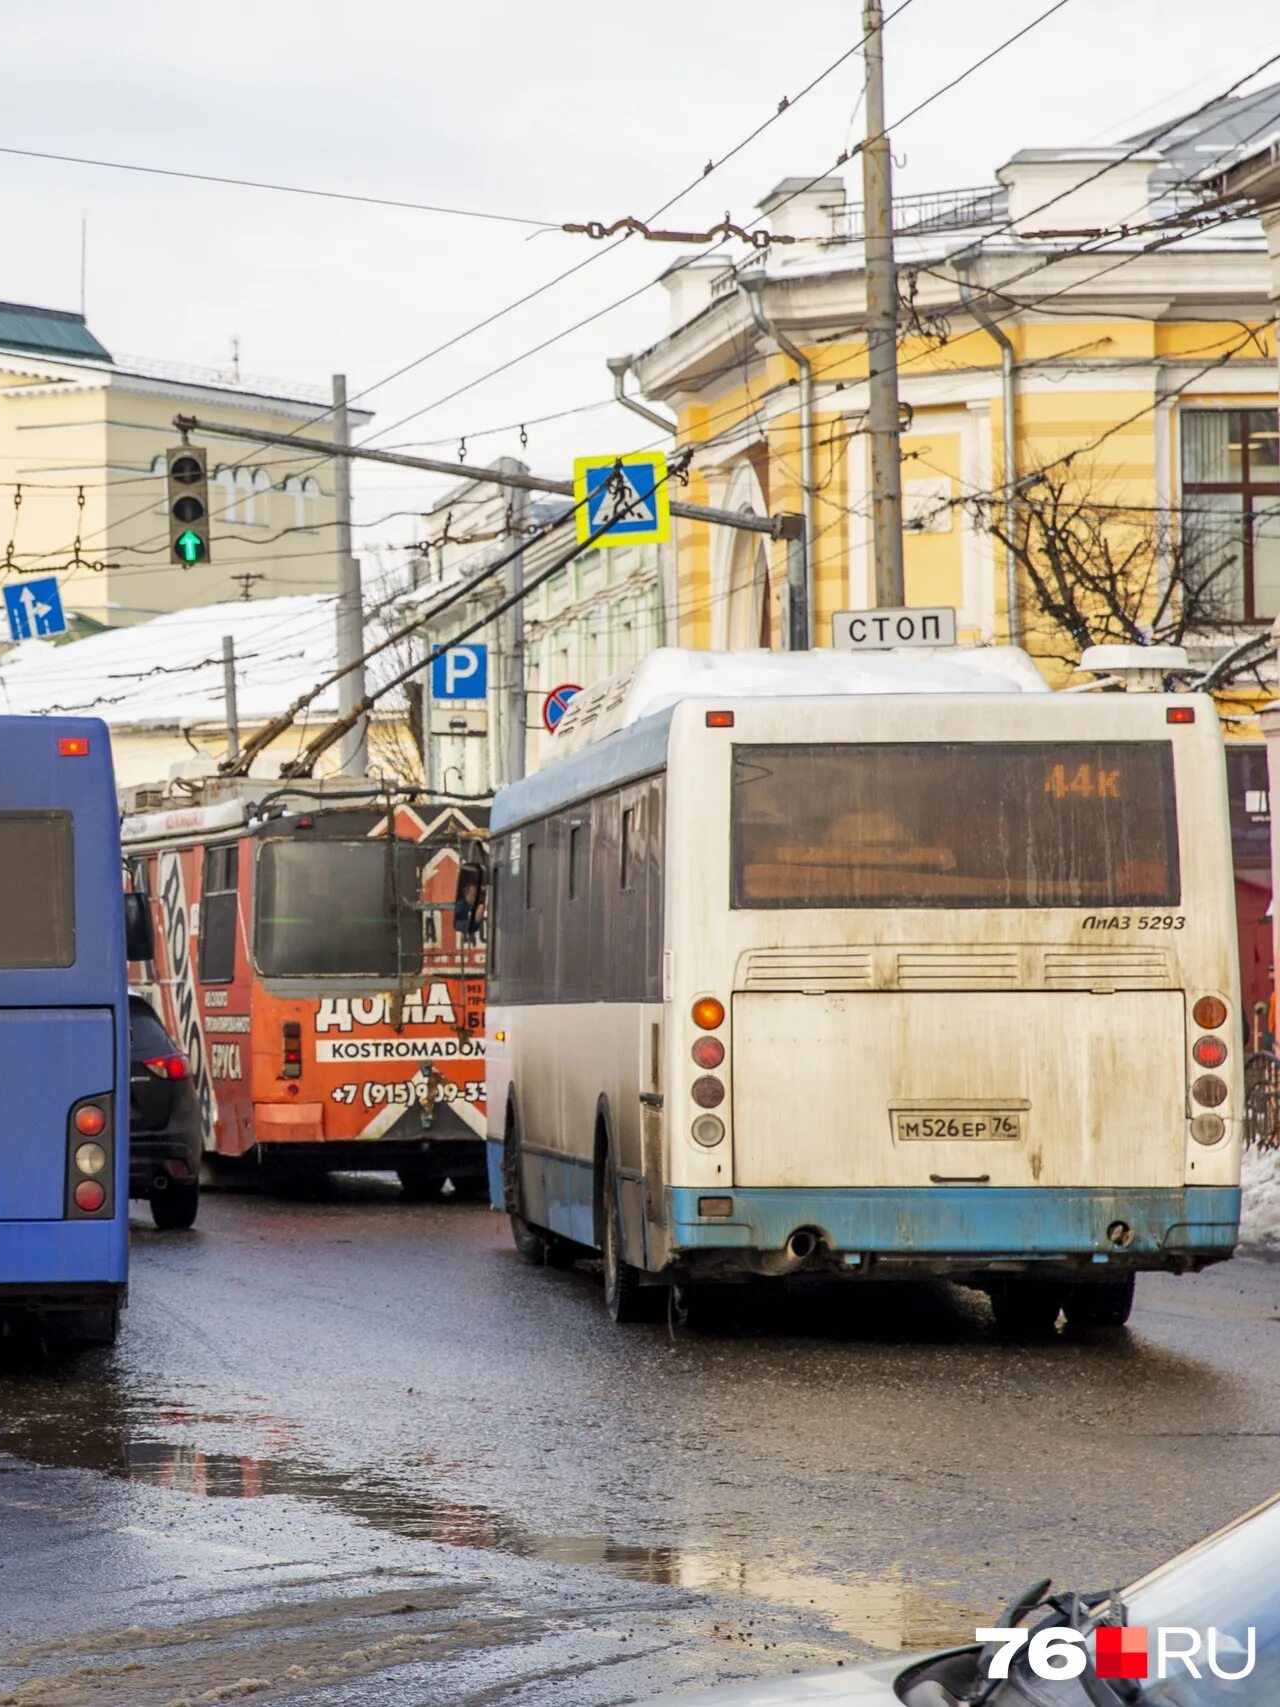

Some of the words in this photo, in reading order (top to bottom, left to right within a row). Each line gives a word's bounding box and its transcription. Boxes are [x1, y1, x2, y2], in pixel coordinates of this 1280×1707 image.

[849, 616, 940, 642] СТОП
[446, 647, 478, 694] P
[1137, 916, 1186, 930] 5293
[331, 1083, 357, 1104] +7
[992, 1117, 1012, 1133] 76
